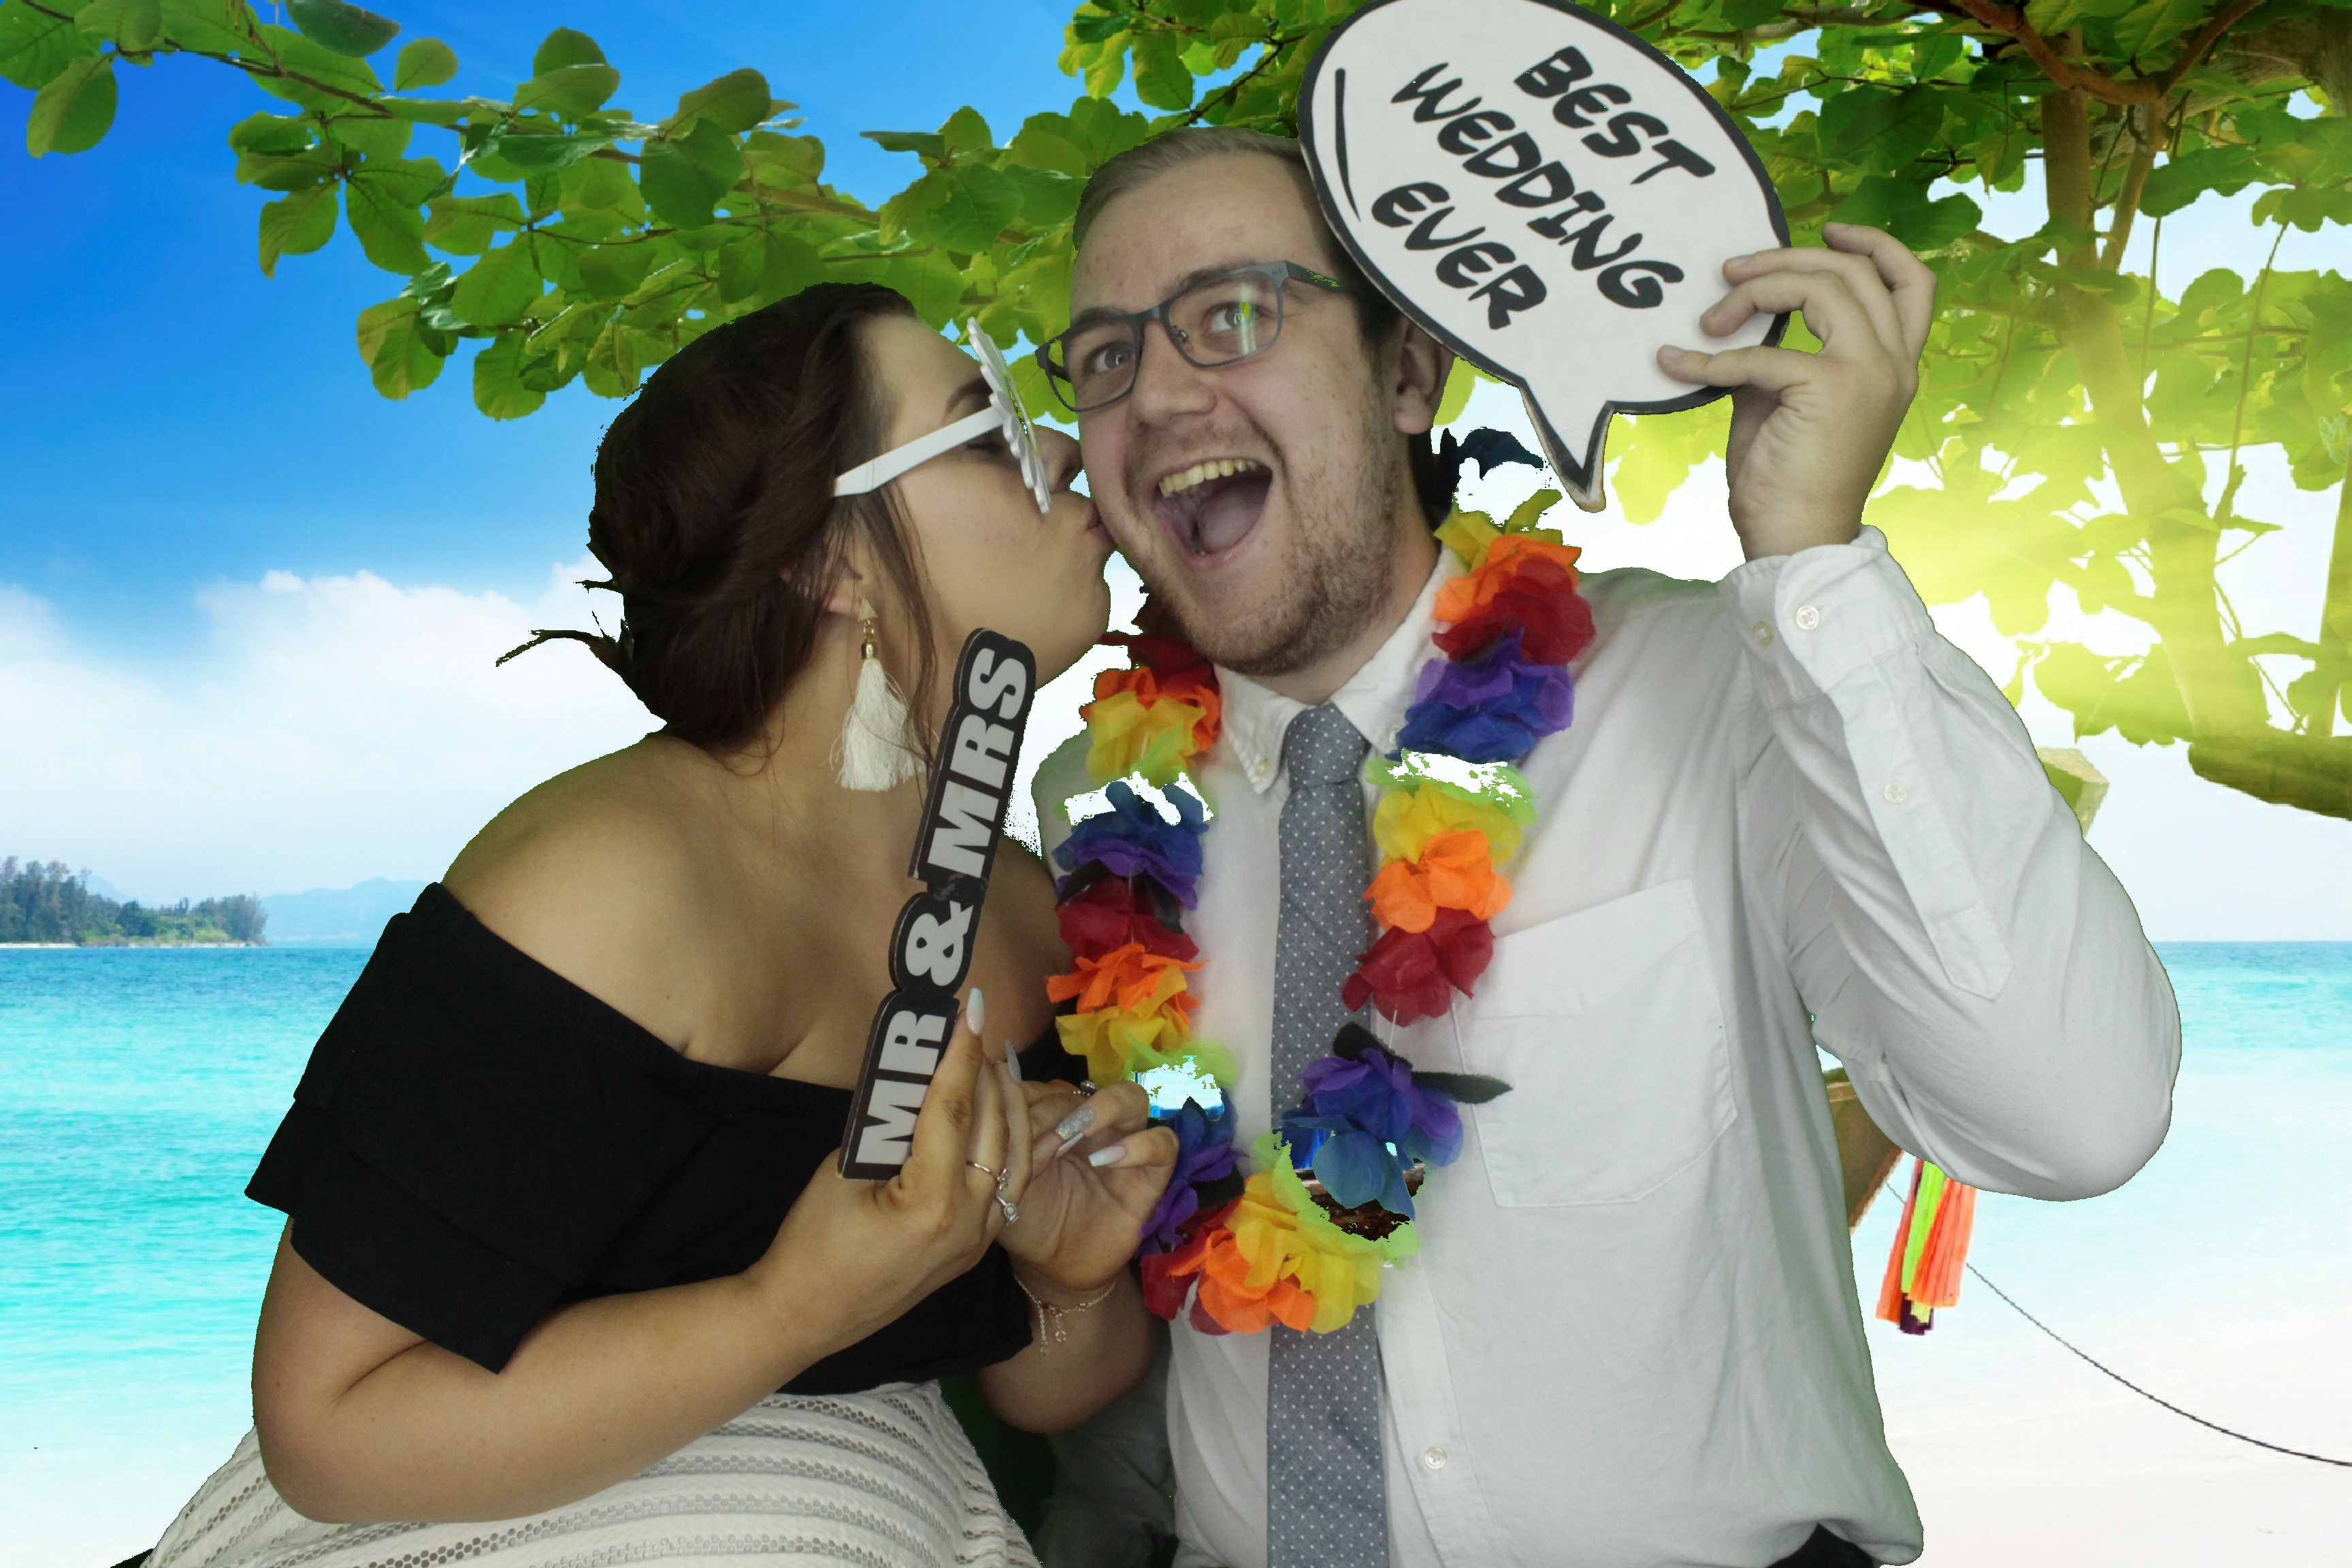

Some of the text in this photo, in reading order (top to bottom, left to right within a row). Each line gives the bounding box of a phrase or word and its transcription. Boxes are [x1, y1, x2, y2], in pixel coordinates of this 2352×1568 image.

[1390, 62, 1684, 308] WEDDING
[1514, 45, 1716, 185] BEST
[1371, 182, 1547, 329] EVER
[855, 647, 1028, 1166] MR & MRS
